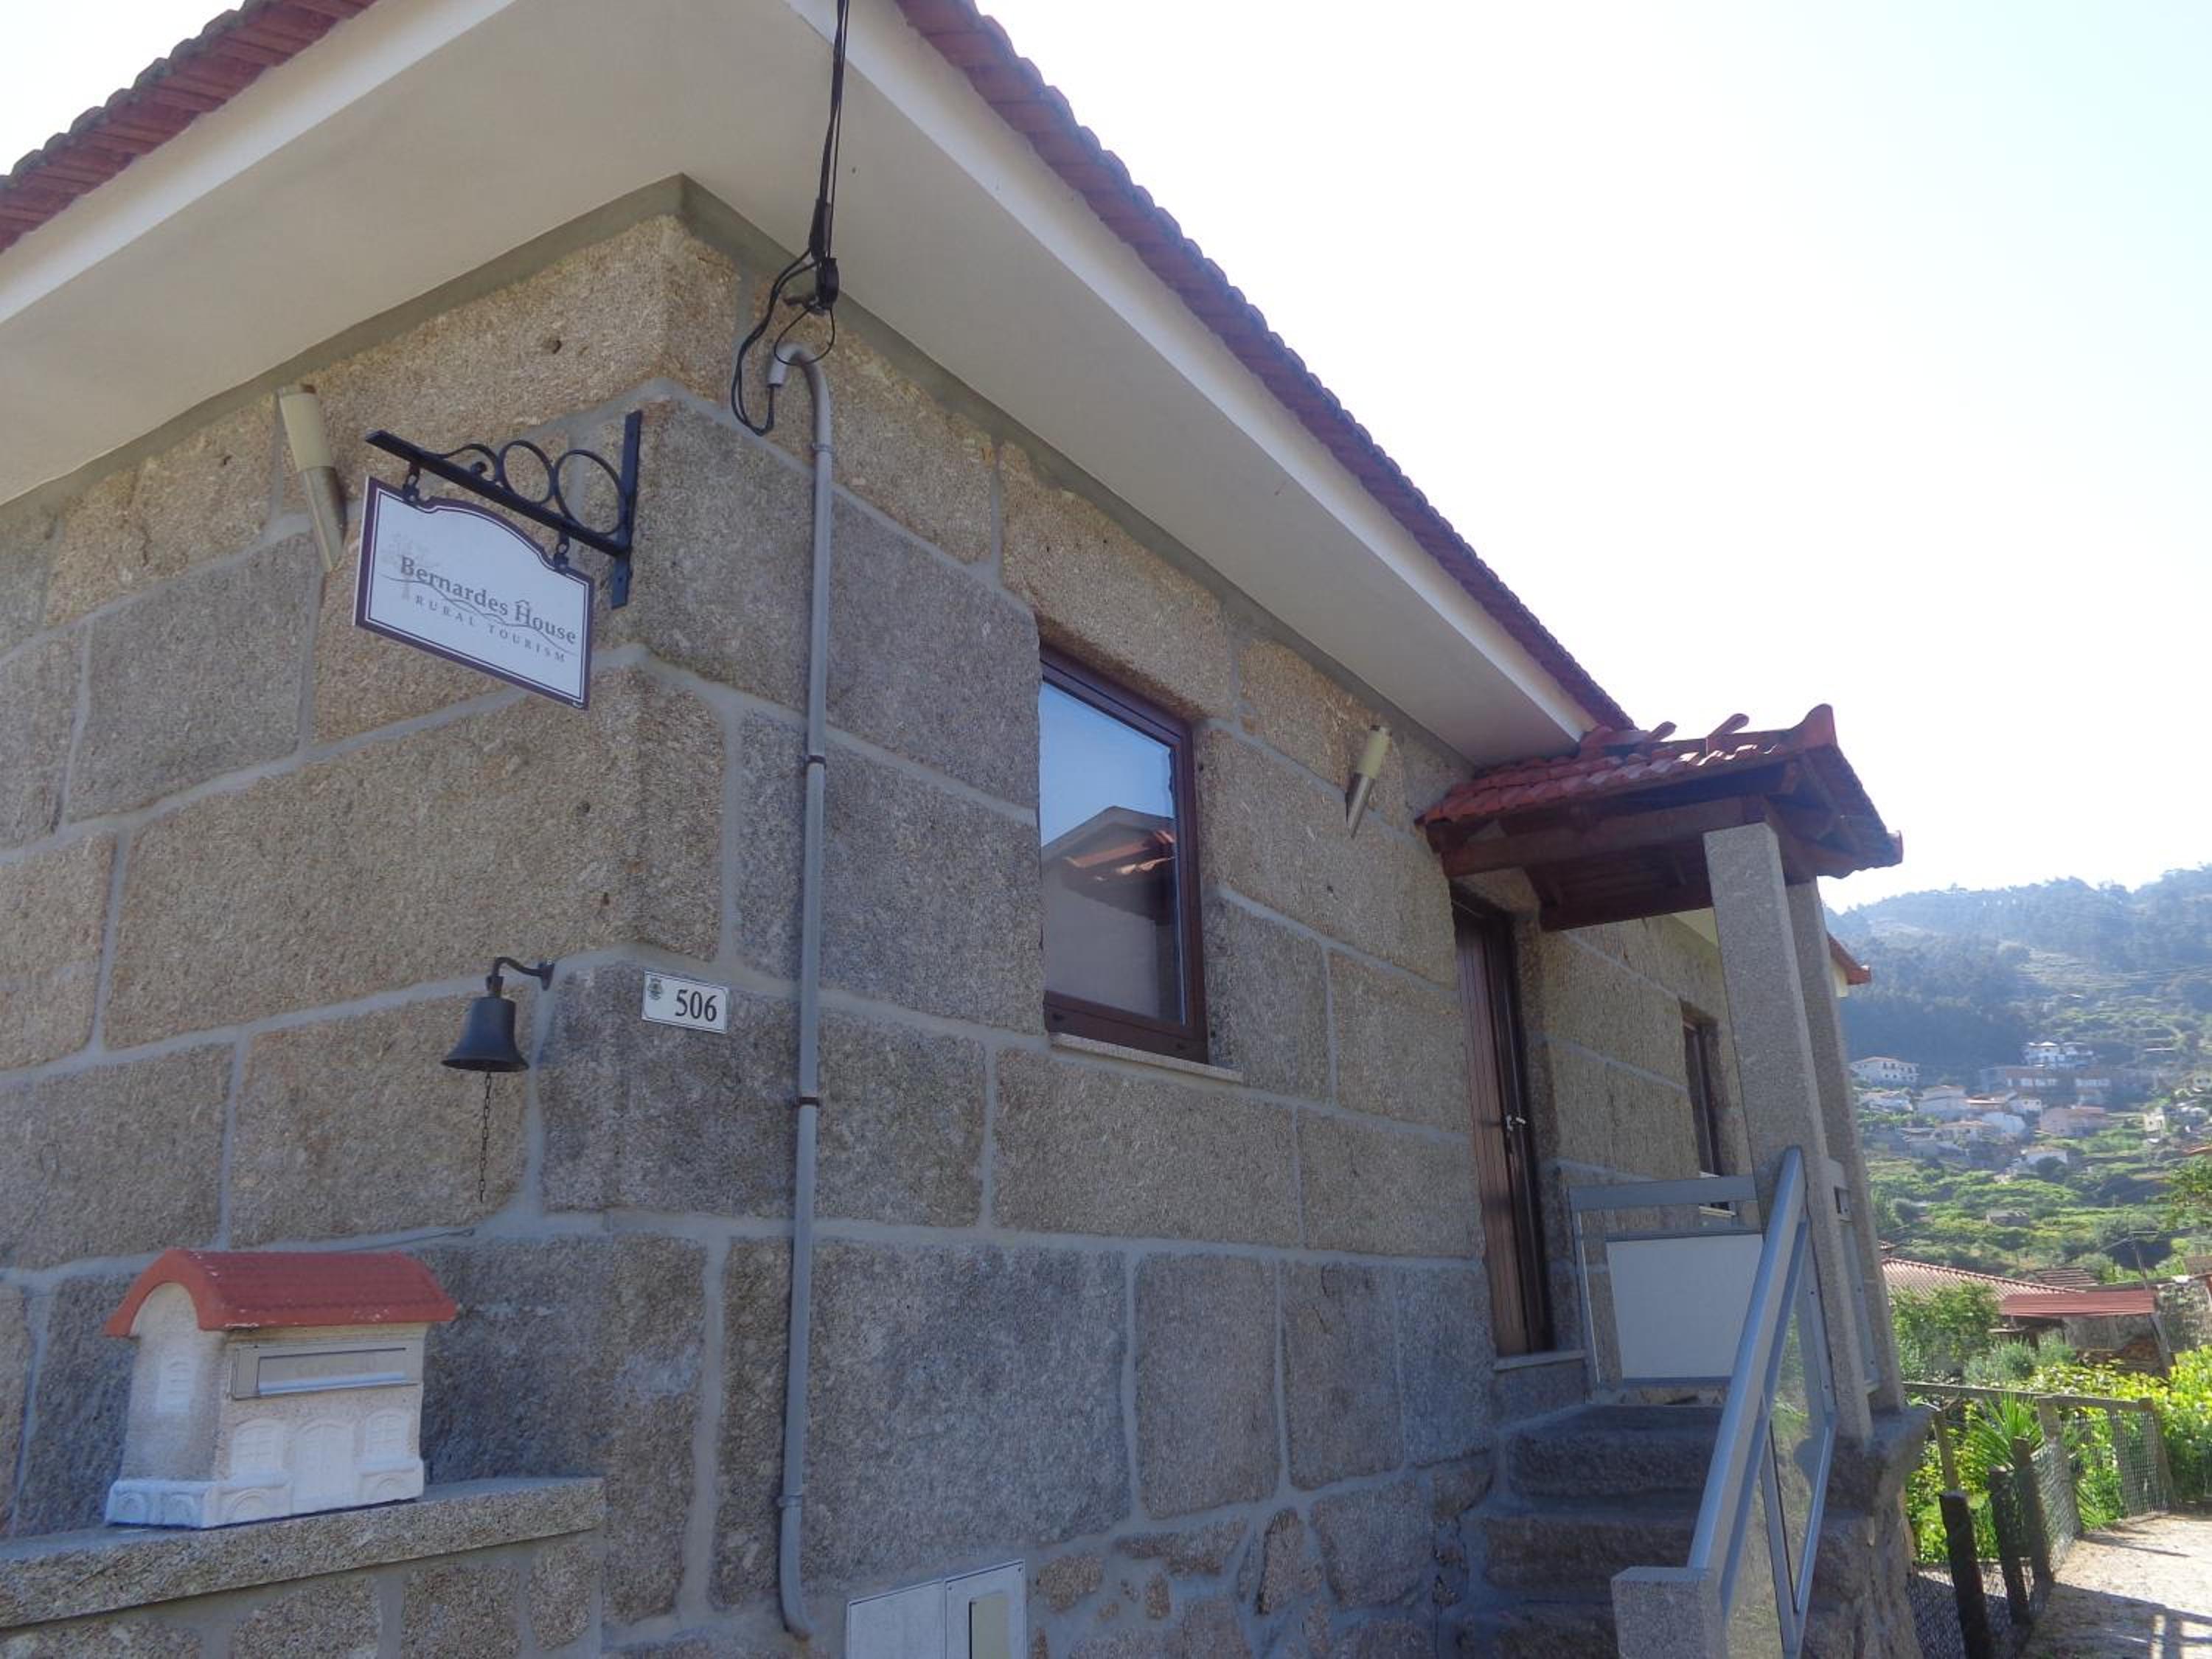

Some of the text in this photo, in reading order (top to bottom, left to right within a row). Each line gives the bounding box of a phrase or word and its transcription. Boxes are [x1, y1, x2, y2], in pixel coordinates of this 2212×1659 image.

[400, 555, 577, 644] Bernardes House
[415, 595, 565, 662] RURAL TOURISM
[675, 989, 717, 1022] 506
